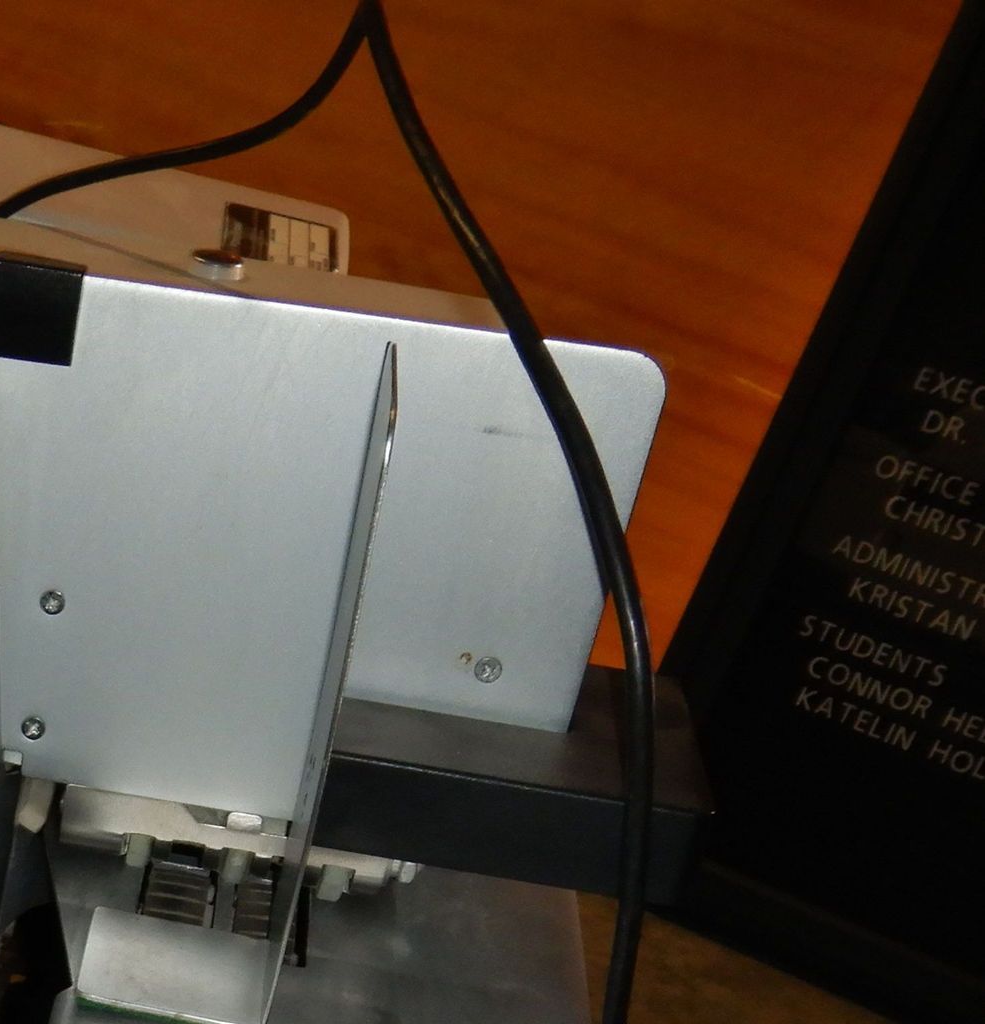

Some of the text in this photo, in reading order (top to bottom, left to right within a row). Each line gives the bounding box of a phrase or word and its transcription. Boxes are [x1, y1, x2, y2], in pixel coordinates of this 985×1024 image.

[914, 366, 985, 411] EXEC
[921, 410, 967, 445] DR.
[875, 455, 981, 505] OFFICE
[885, 495, 985, 547] CHRIST
[848, 577, 978, 641] KRISTAN
[800, 615, 948, 687] STUDENTS
[808, 656, 933, 719] CONNOR
[796, 686, 917, 751] KATELIN
